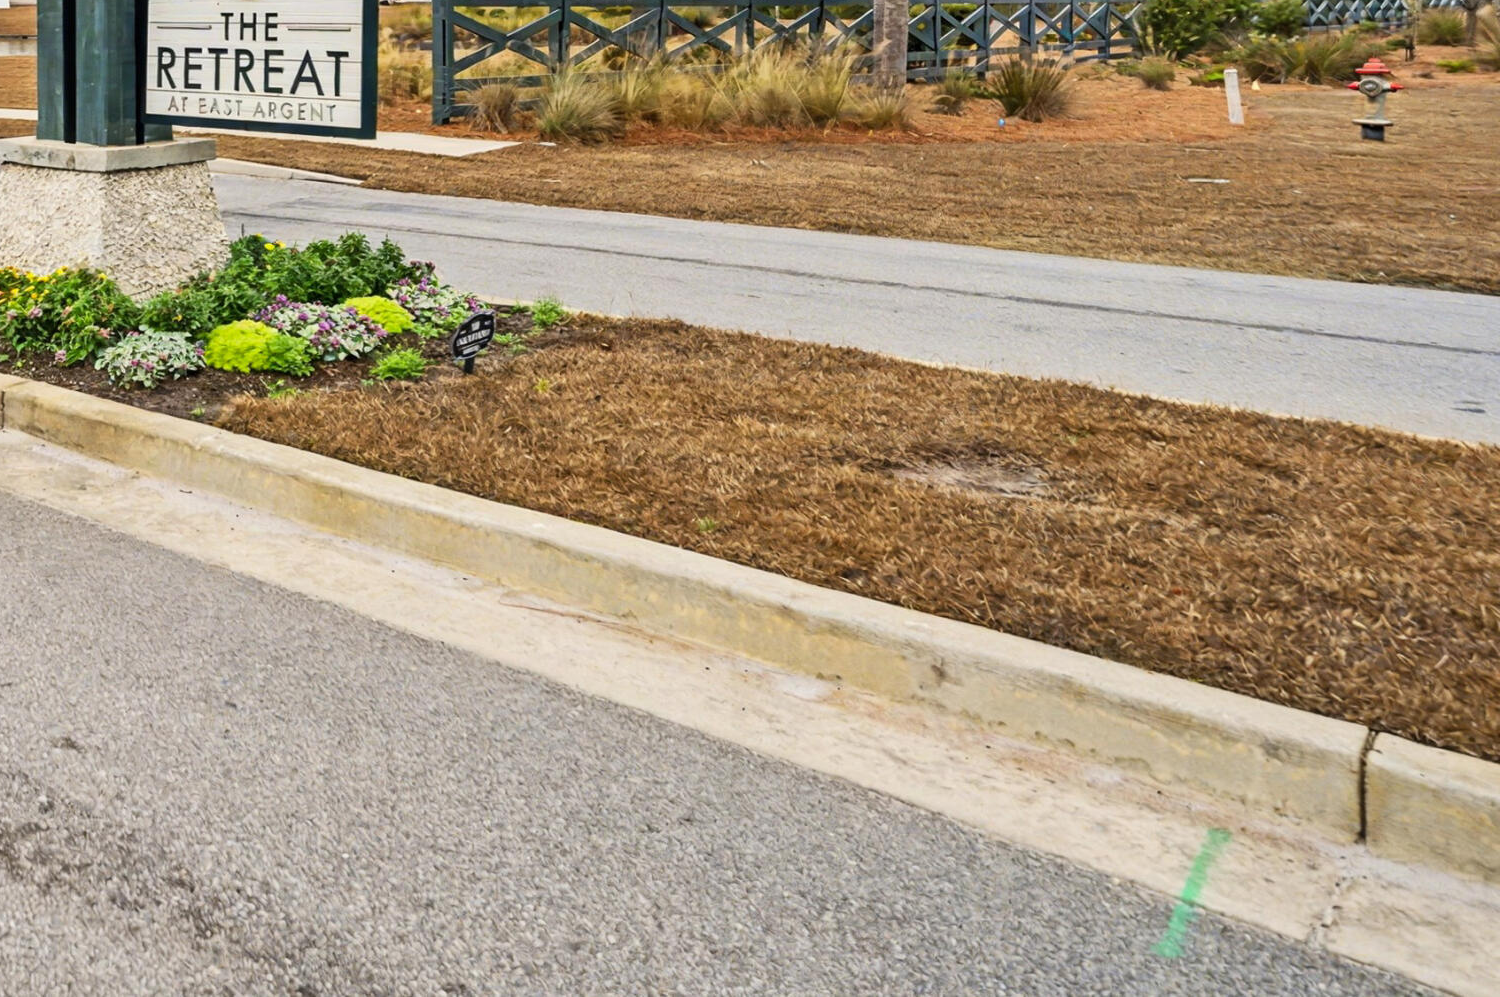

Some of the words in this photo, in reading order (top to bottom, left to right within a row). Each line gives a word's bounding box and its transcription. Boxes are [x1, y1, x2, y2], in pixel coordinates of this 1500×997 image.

[220, 12, 278, 41] THE
[157, 47, 349, 97] RETREAT
[167, 96, 188, 112] AT
[199, 98, 243, 116] EAST
[253, 102, 336, 122] ARGENT
